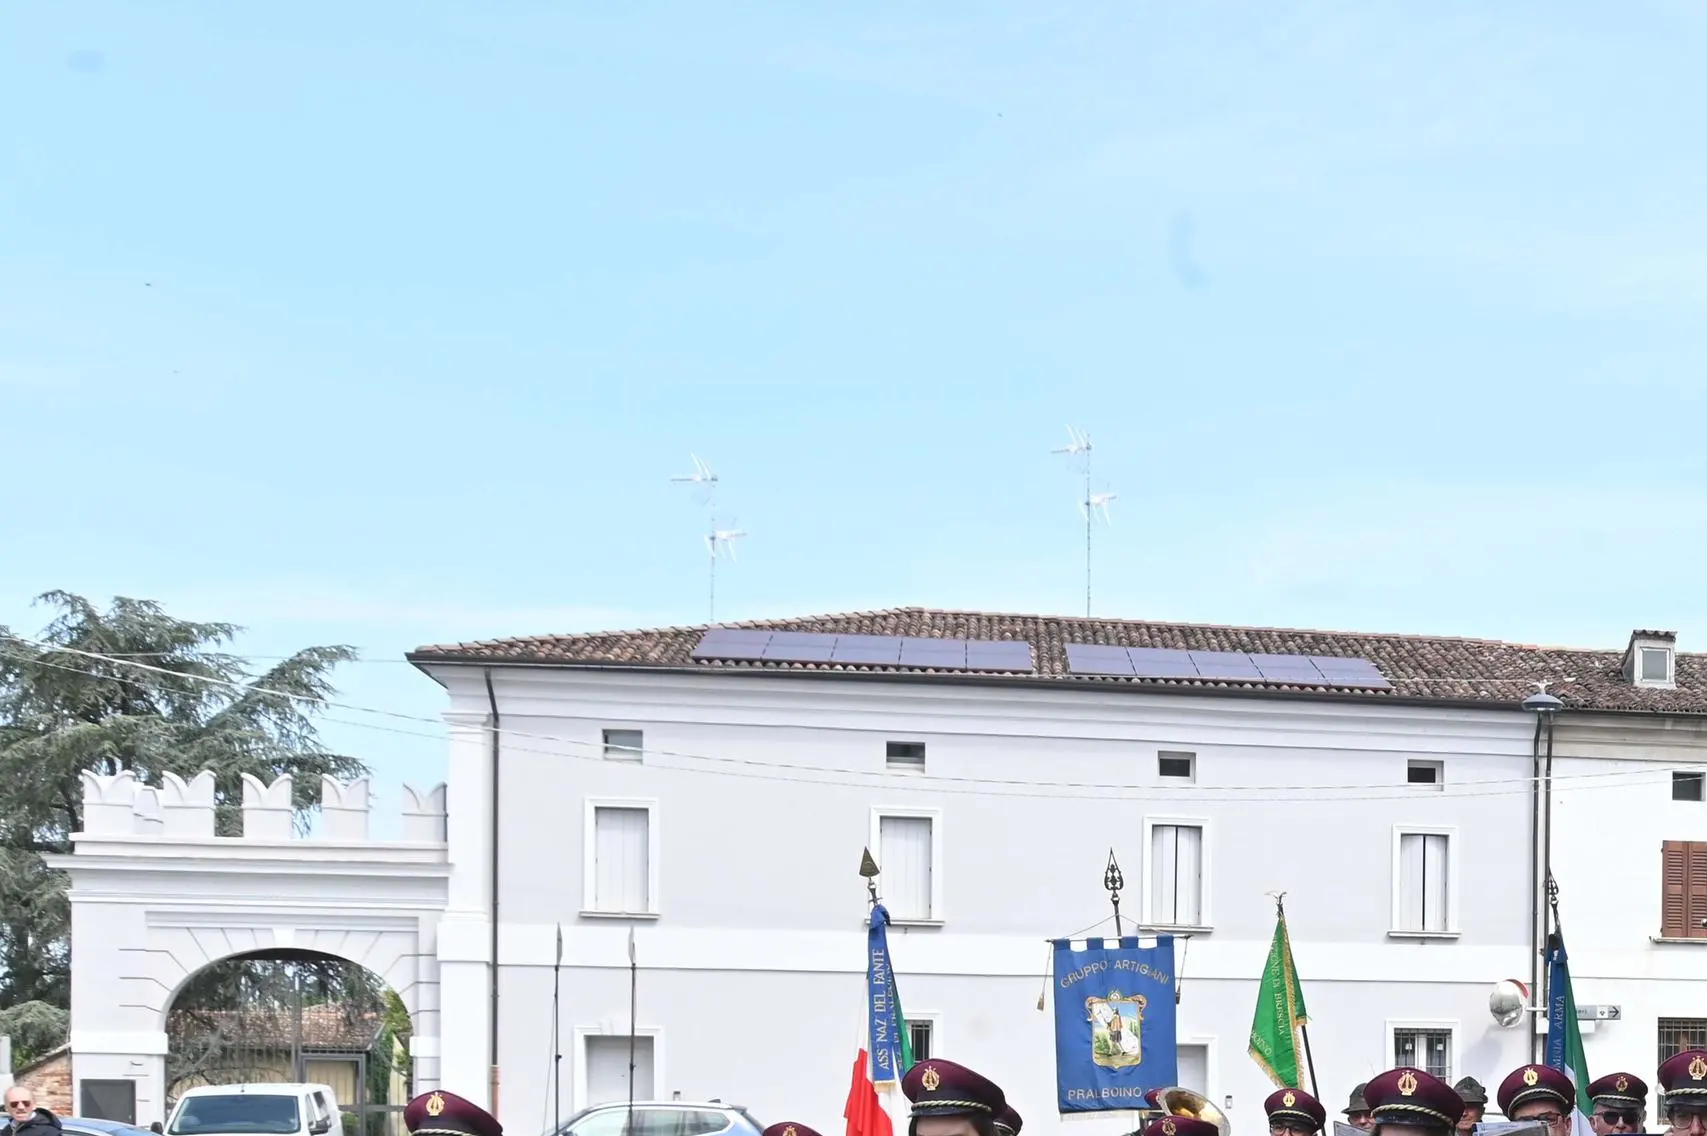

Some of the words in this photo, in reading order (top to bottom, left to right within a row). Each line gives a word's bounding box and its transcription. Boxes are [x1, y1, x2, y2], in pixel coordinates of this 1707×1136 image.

[872, 948, 885, 985] FANTE
[1061, 961, 1108, 988] GRUPPO
[1114, 960, 1169, 985] ARTIGIANI
[873, 990, 887, 1013] DEL
[1274, 993, 1286, 1036] BRESCIA
[1554, 995, 1565, 1030] ARMA
[1067, 1086, 1142, 1100] PRALBOINO
